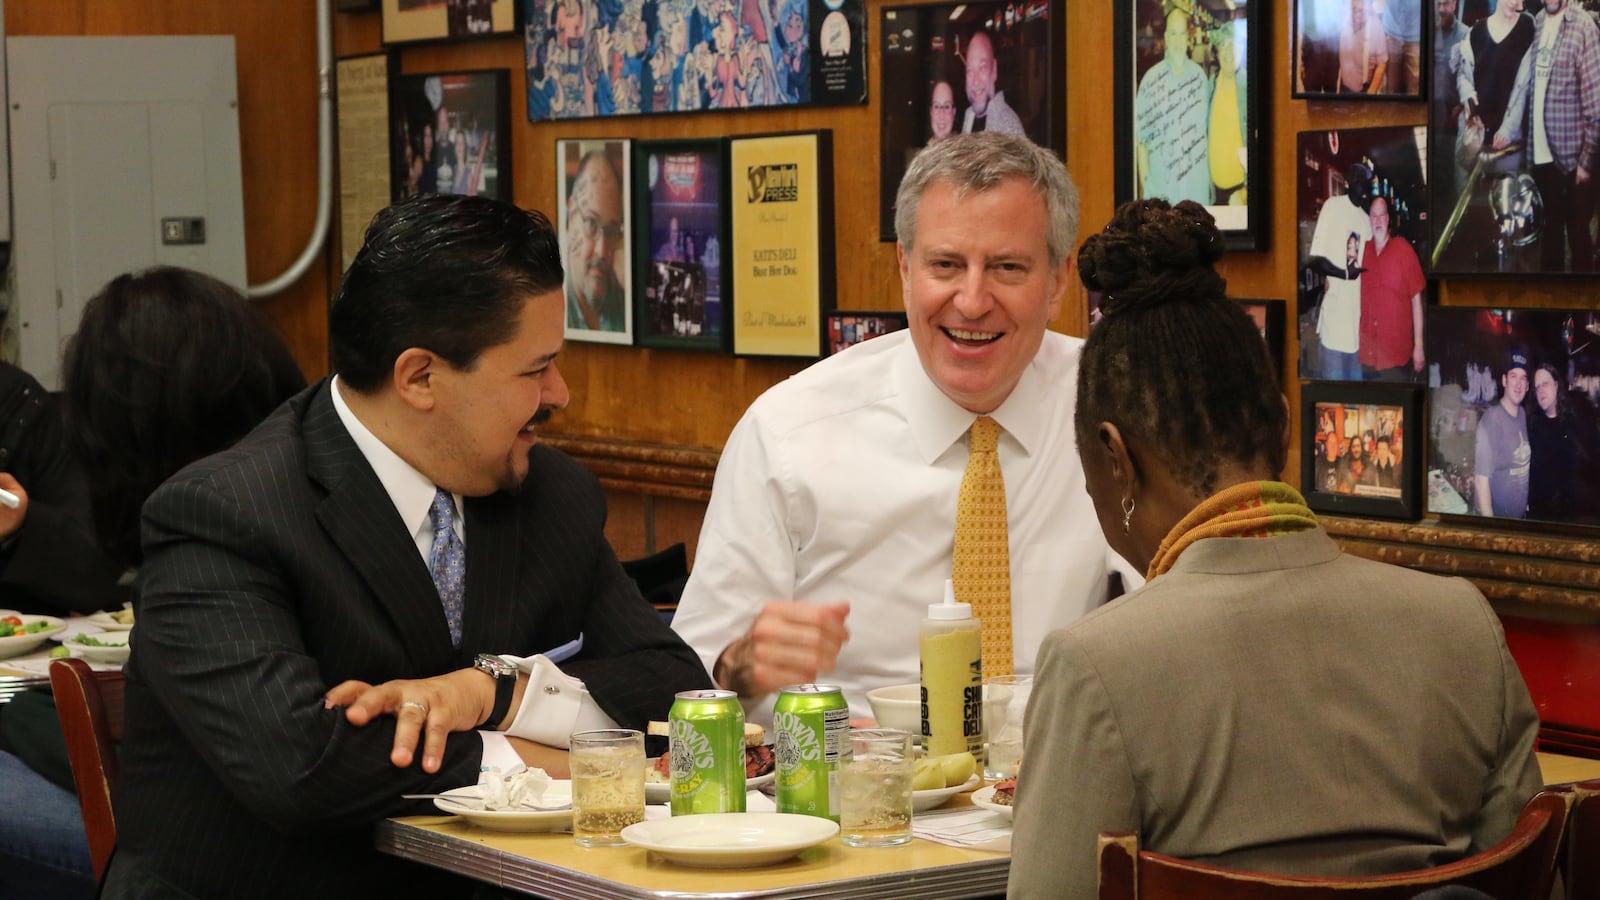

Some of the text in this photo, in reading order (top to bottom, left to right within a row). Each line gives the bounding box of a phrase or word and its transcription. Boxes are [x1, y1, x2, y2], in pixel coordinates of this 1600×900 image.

[766, 187, 797, 201] PRESS
[779, 248, 797, 261] DELI
[669, 719, 715, 769] ROWN'S
[774, 711, 821, 761] ROWN'S
